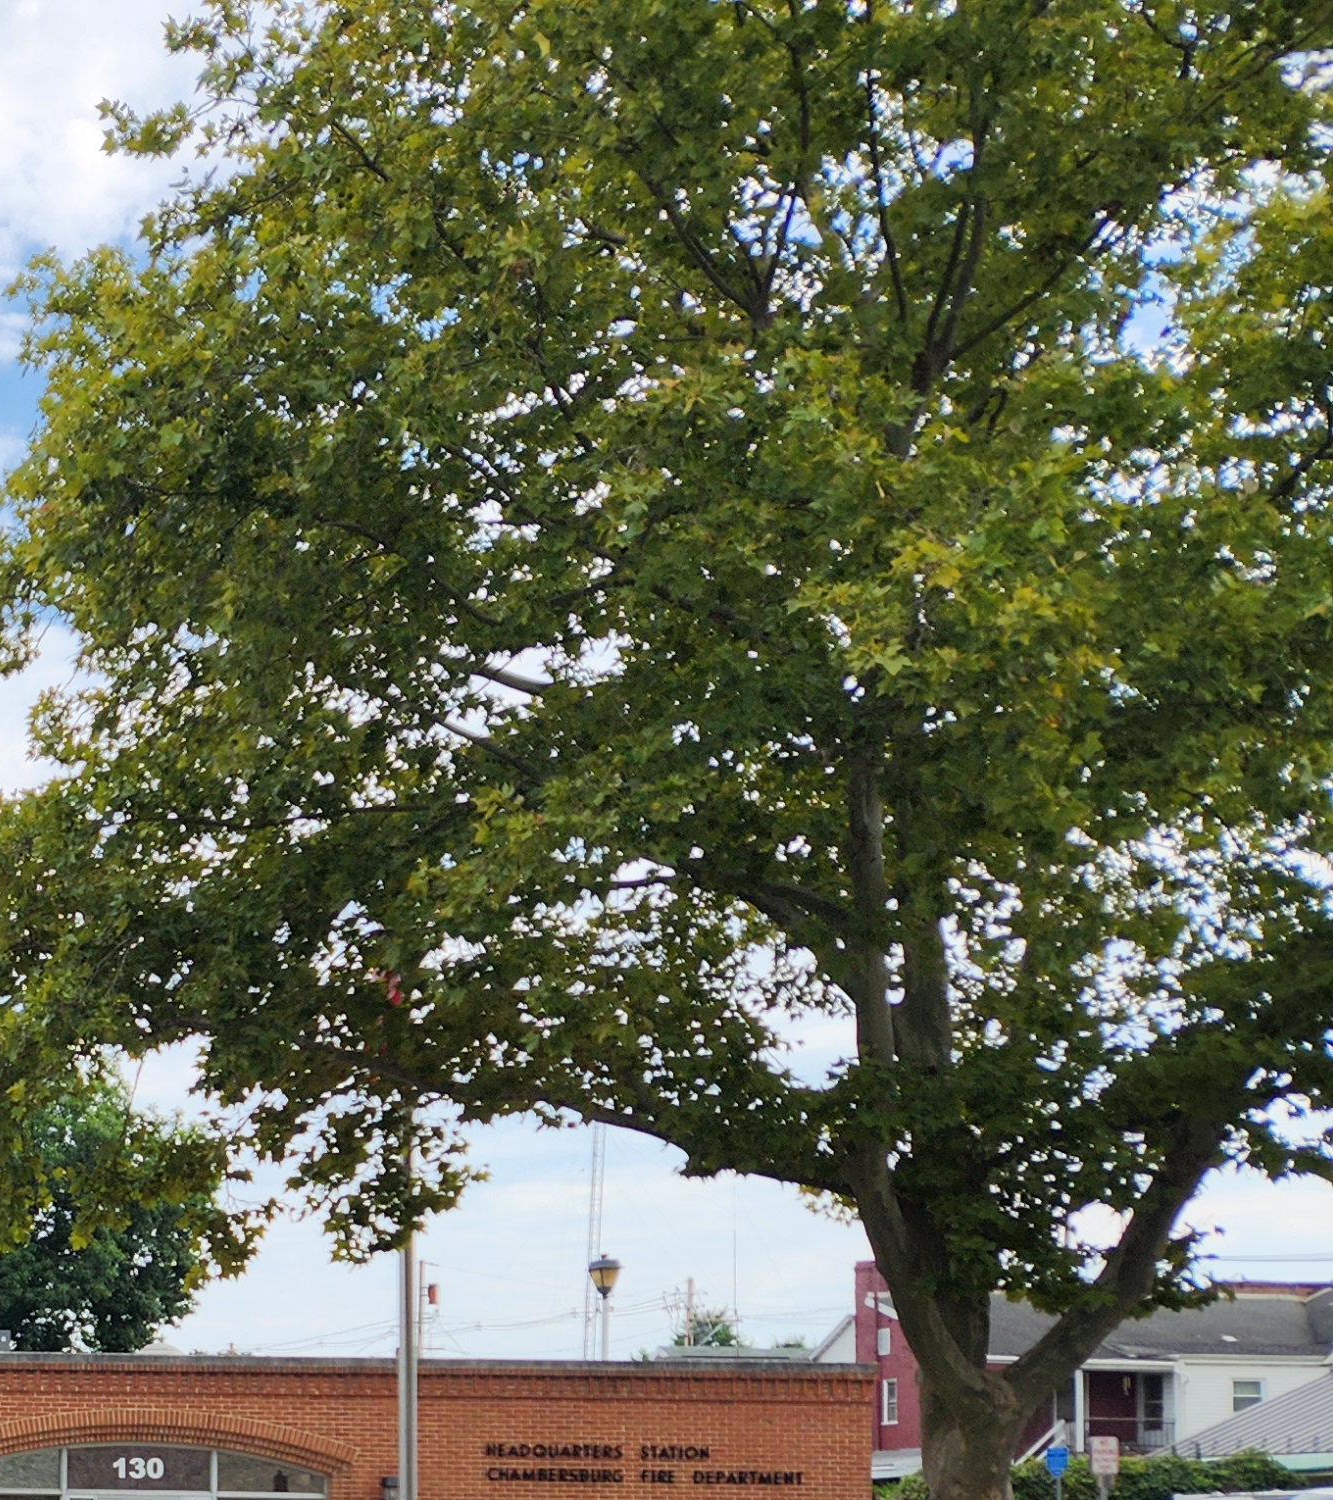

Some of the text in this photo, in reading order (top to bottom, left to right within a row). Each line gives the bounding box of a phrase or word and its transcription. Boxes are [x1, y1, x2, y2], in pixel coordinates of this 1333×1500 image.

[485, 1443, 710, 1460] HEADQUARTERS STATION
[112, 1457, 165, 1480] 130
[486, 1467, 804, 1486] CHAMBERSBURG FIRE DEPARTMENT
